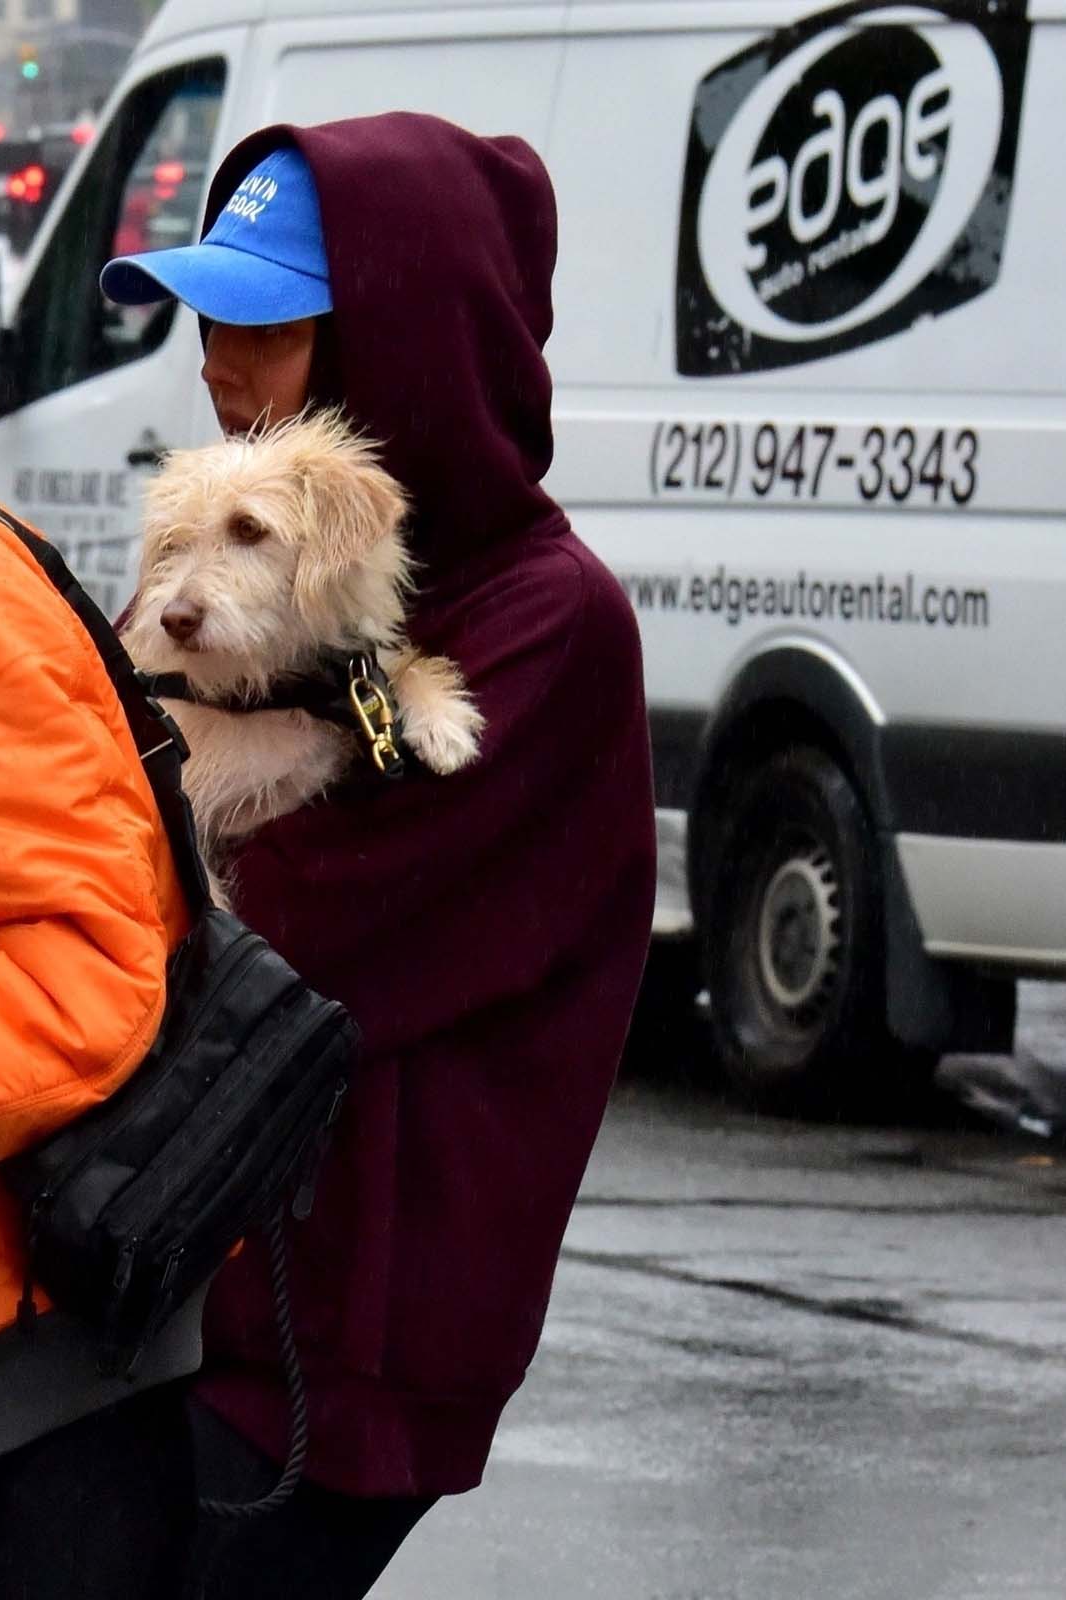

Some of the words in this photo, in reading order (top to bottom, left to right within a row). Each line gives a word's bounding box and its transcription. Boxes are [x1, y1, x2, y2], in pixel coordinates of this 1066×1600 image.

[225, 194, 267, 223] COOL
[742, 70, 952, 272] edge
[648, 421, 743, 498] (212)
[750, 422, 980, 506] 947-3343
